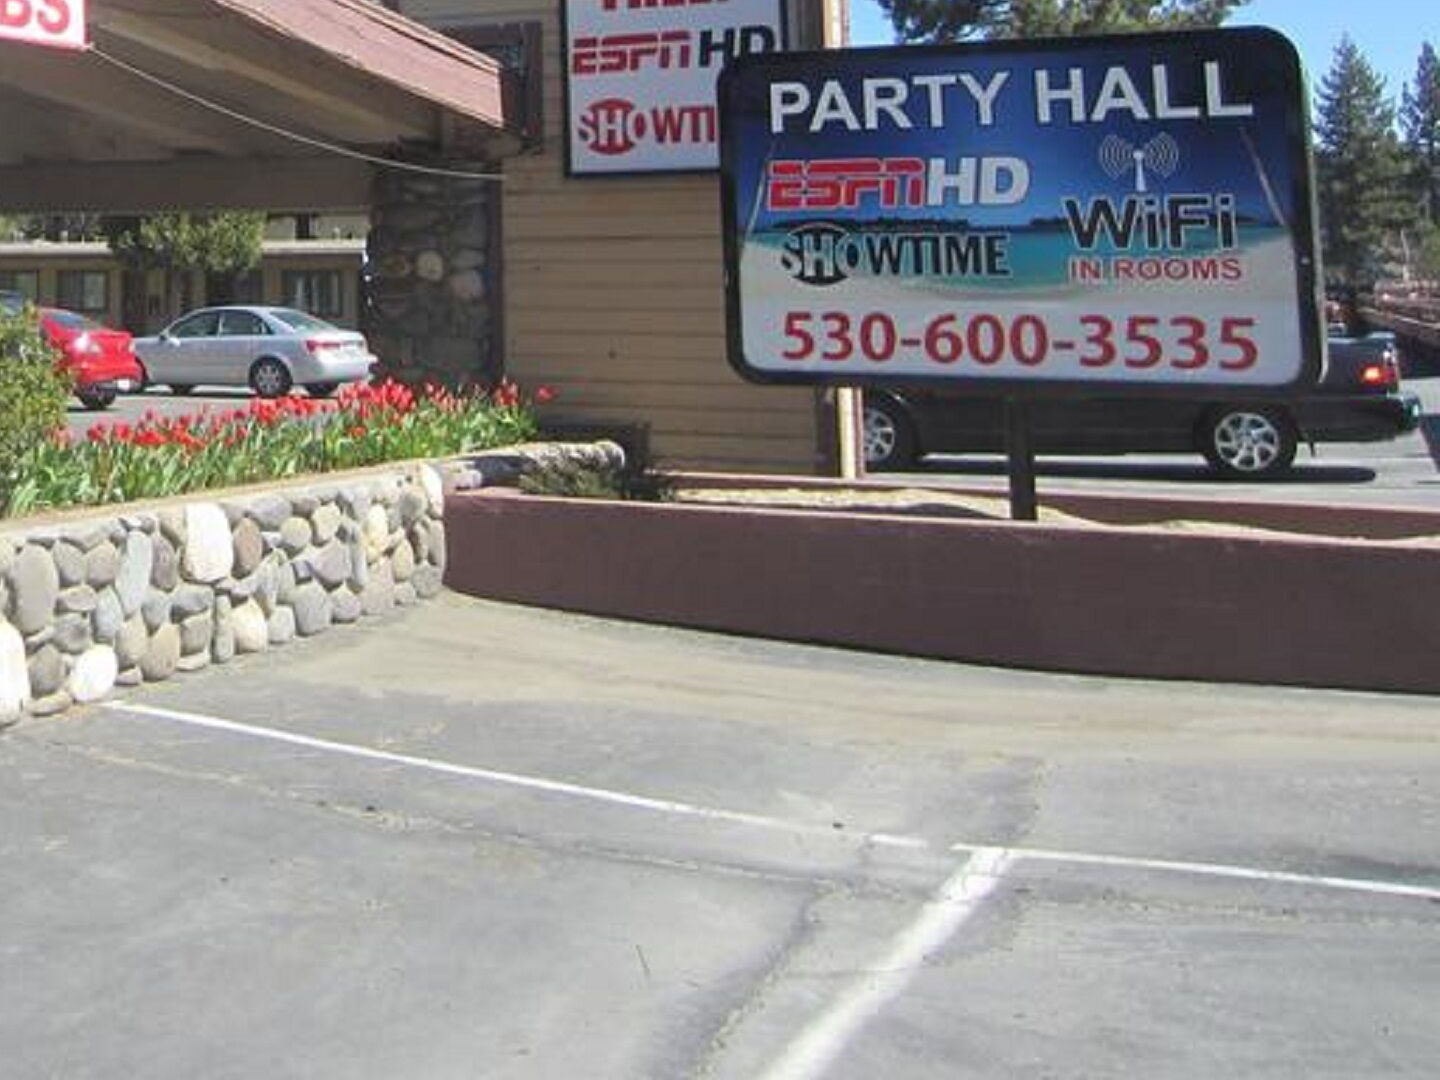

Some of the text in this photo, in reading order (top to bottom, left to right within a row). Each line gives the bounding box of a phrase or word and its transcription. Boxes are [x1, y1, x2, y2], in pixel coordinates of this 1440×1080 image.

[769, 60, 1254, 135] PARTY HALL
[779, 222, 1010, 287] SHOWTIME
[1071, 258, 1243, 281] IN ROOMS
[782, 311, 1260, 372] 530-600-3535
